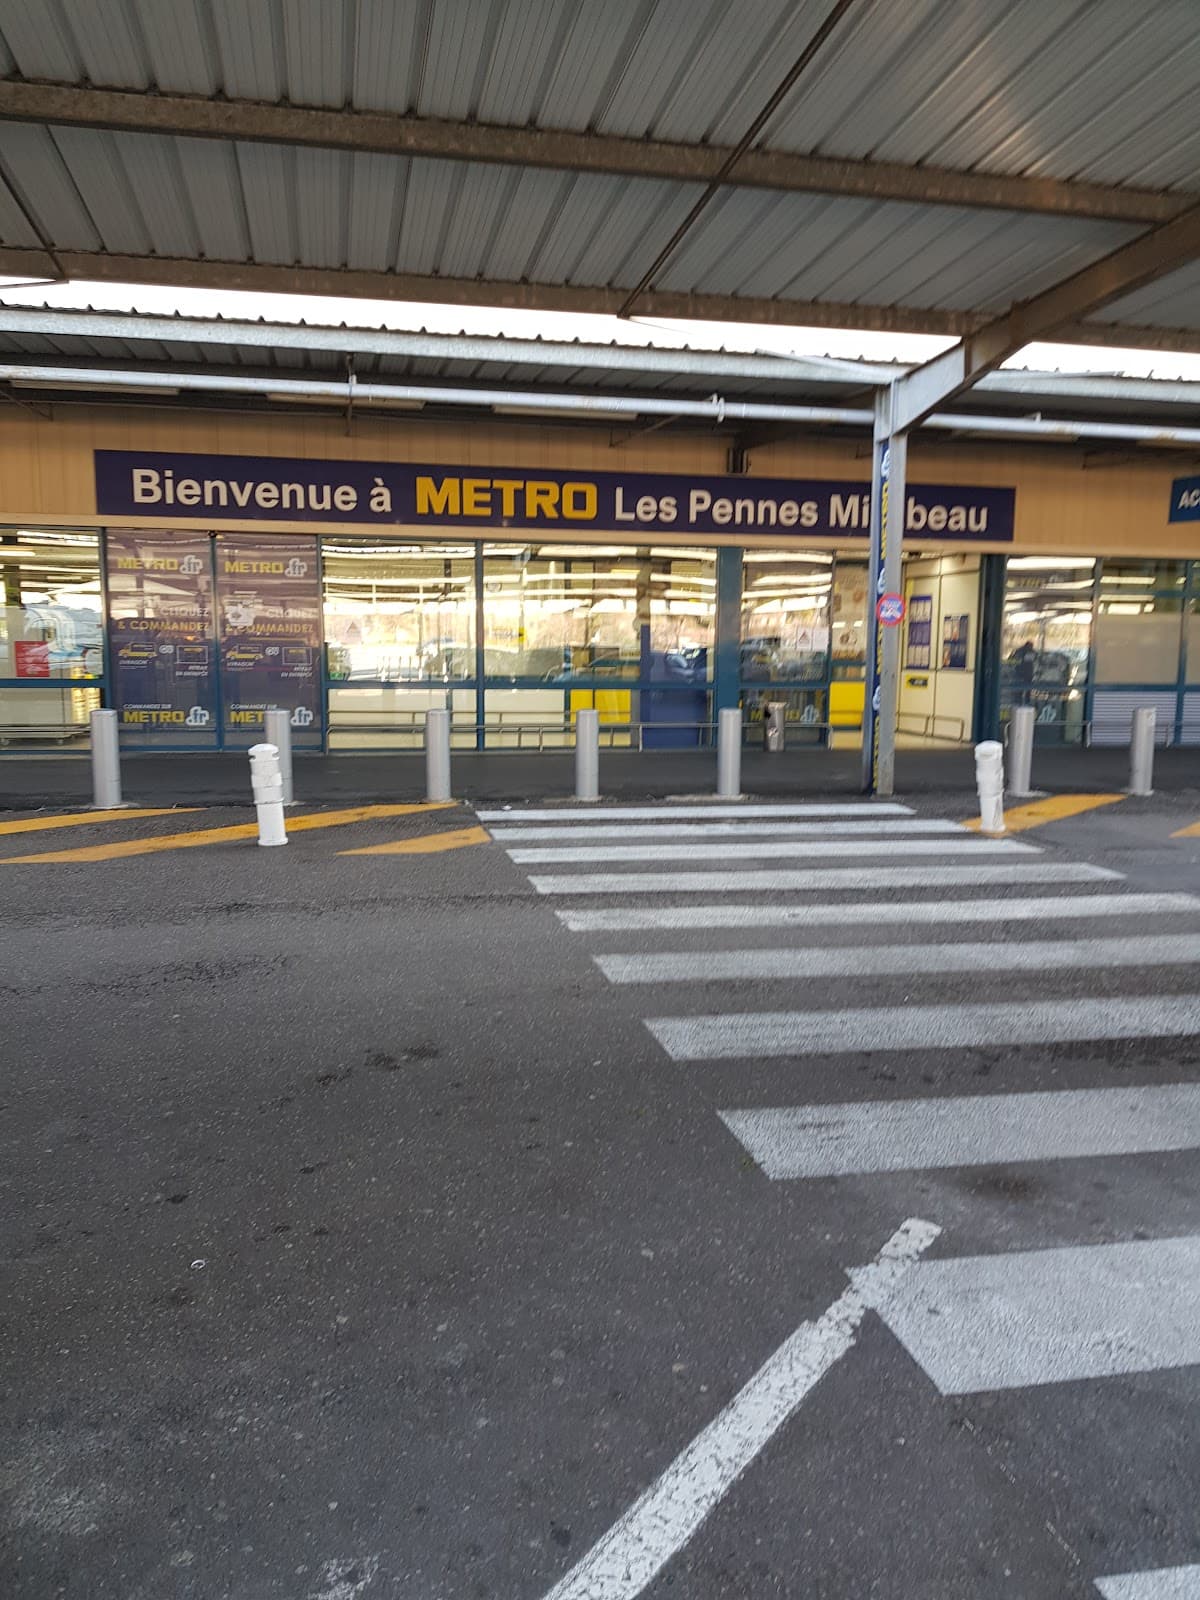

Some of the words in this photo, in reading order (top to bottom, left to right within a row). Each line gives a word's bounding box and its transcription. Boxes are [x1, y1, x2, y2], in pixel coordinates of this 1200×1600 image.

[132, 468, 358, 511] Bienvenue
[369, 477, 393, 513] à
[415, 476, 598, 520] METRO
[614, 486, 678, 524] Les
[688, 489, 819, 527] Pennes
[829, 494, 989, 533] Mibeau
[130, 620, 210, 632] COMMANDEZ
